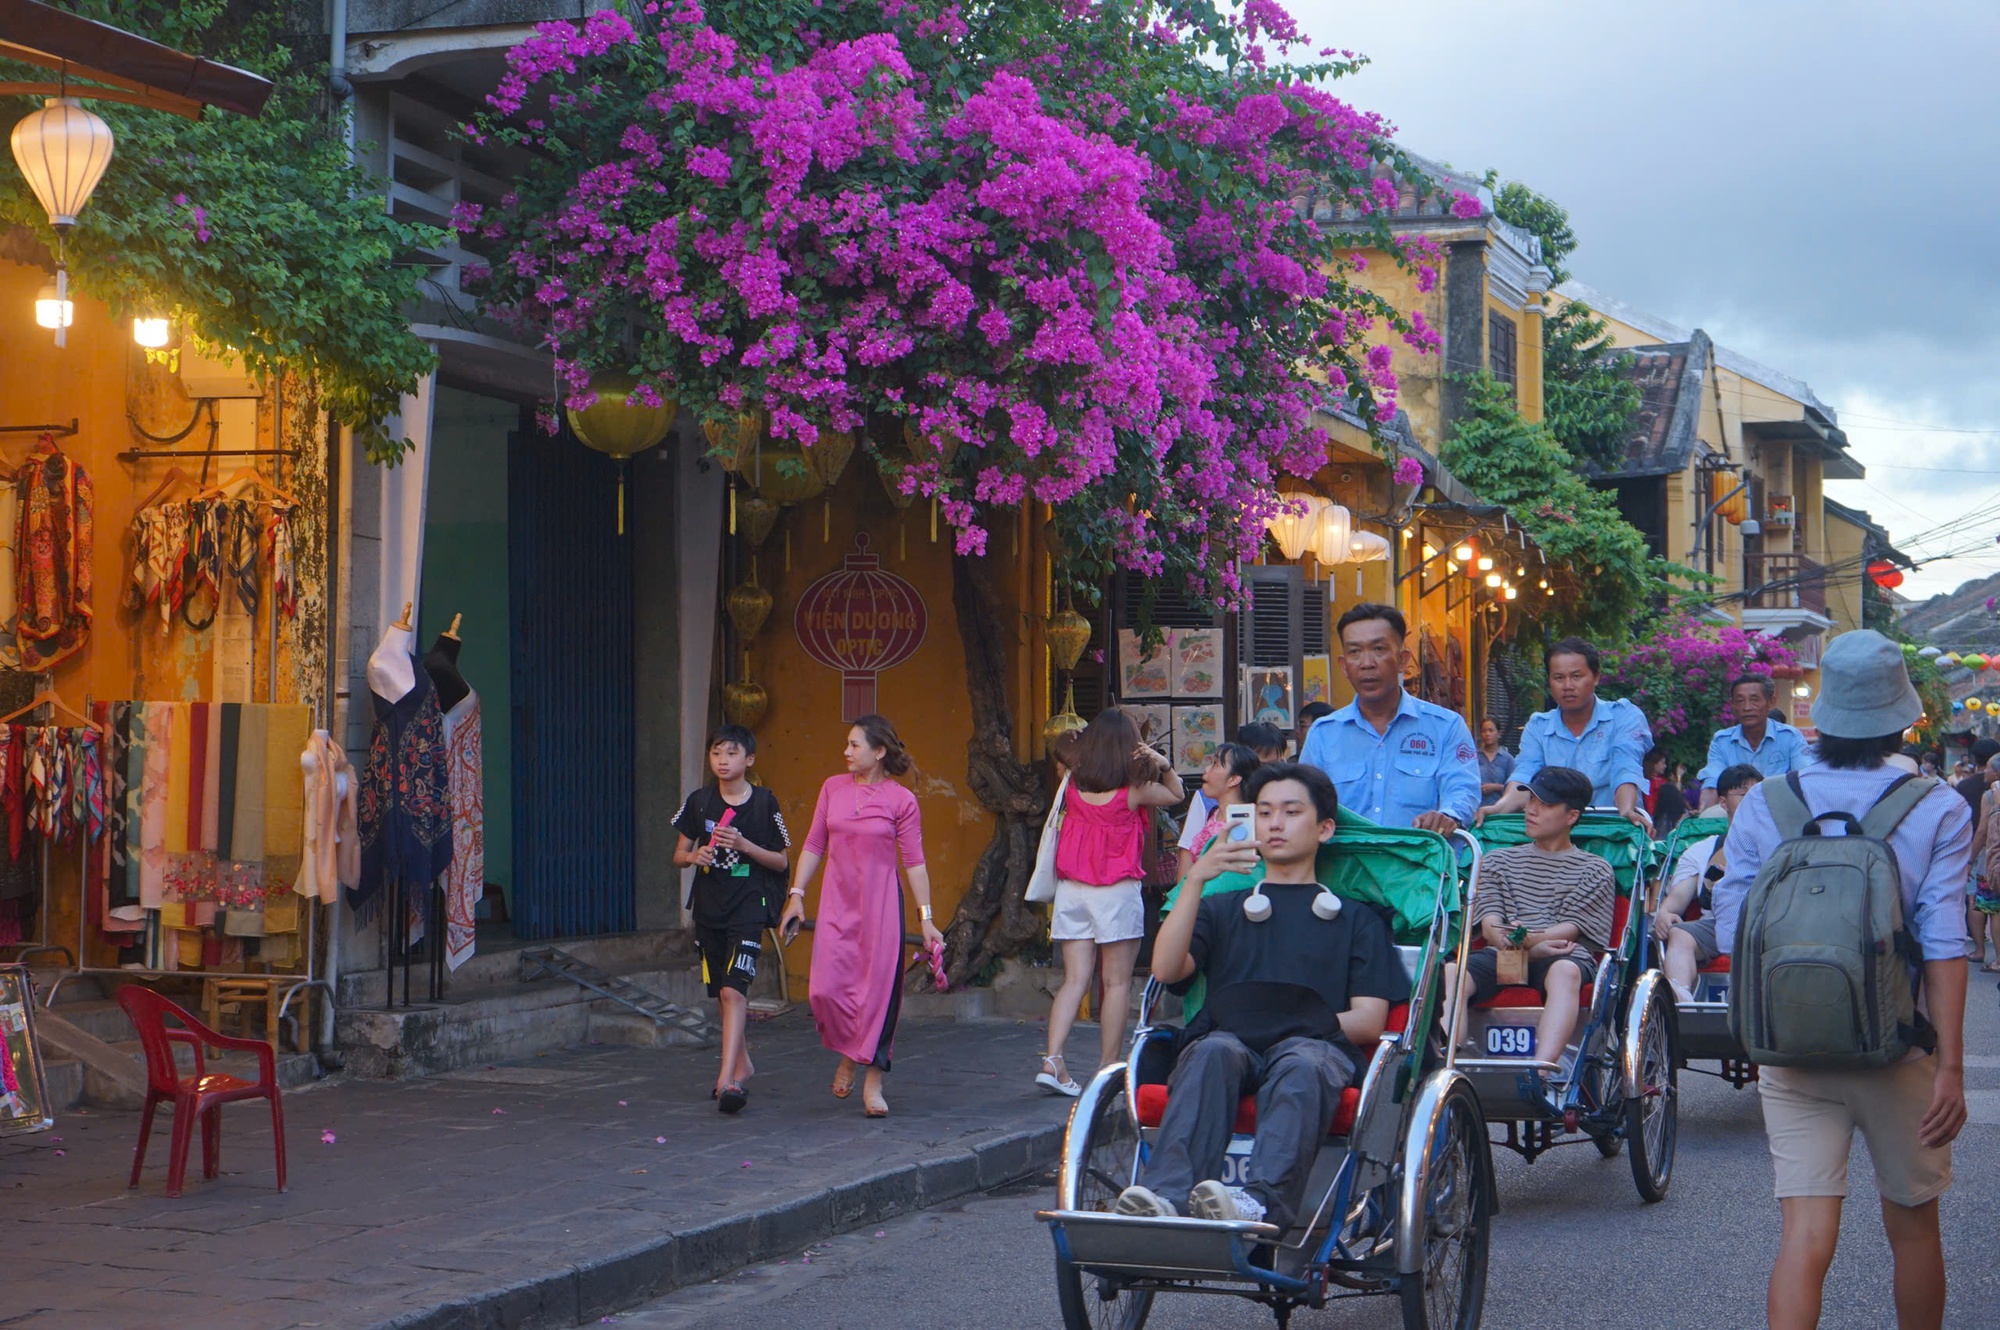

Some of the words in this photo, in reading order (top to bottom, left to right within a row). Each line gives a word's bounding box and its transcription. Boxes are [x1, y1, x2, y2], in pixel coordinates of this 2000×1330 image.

[836, 638, 884, 656] OPTIC
[1410, 739, 1427, 749] 060
[1487, 1028, 1531, 1053] 039
